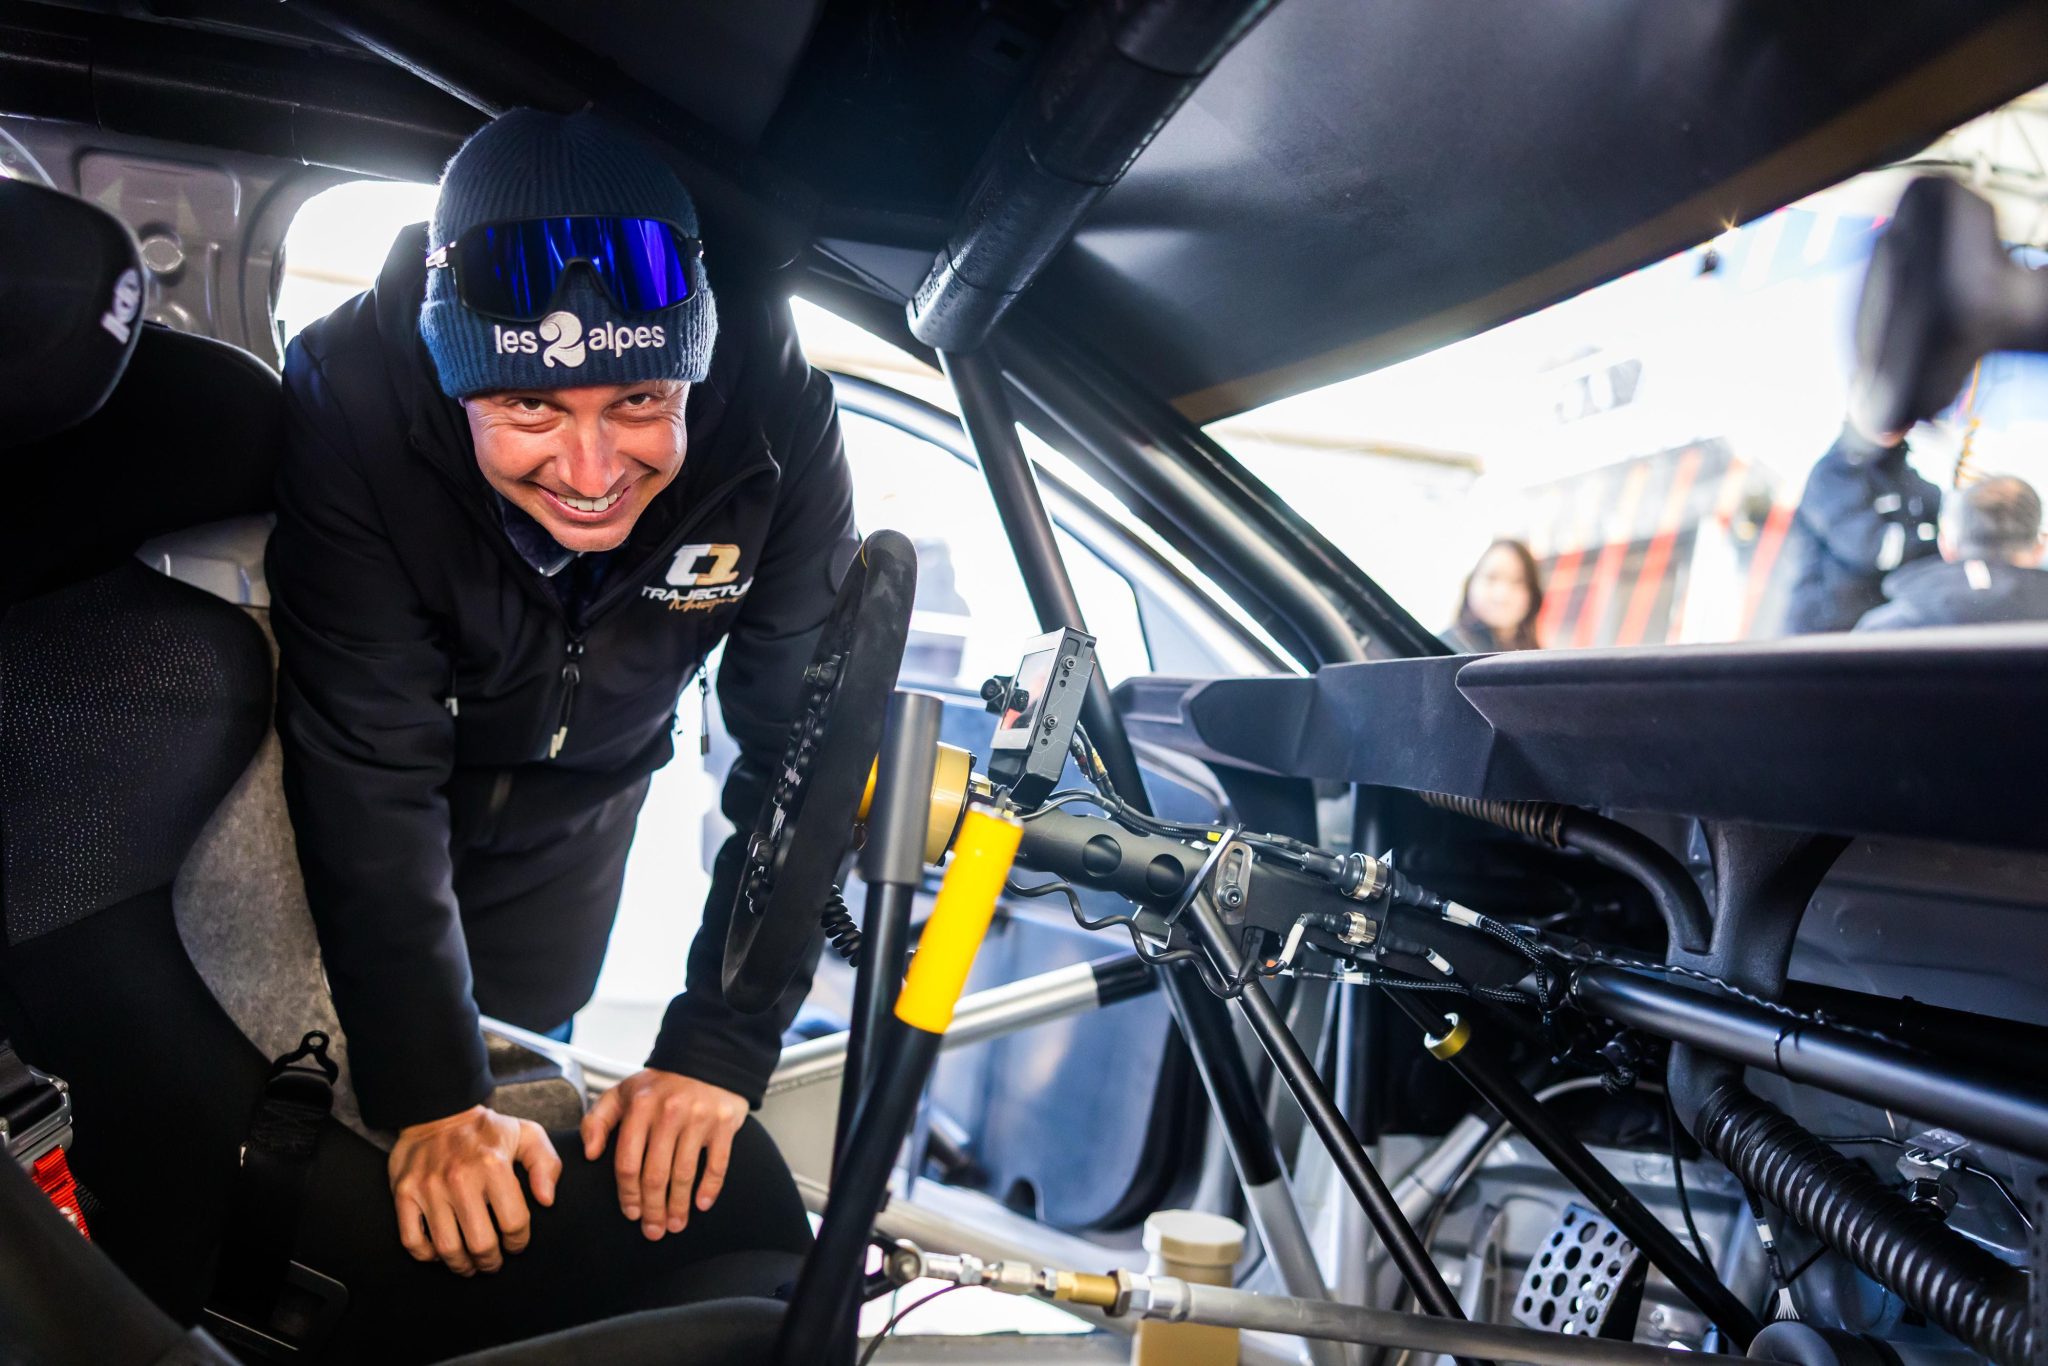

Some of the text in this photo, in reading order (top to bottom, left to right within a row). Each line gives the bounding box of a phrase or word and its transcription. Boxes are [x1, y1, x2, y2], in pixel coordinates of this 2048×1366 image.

[494, 311, 666, 368] les 2 alpes
